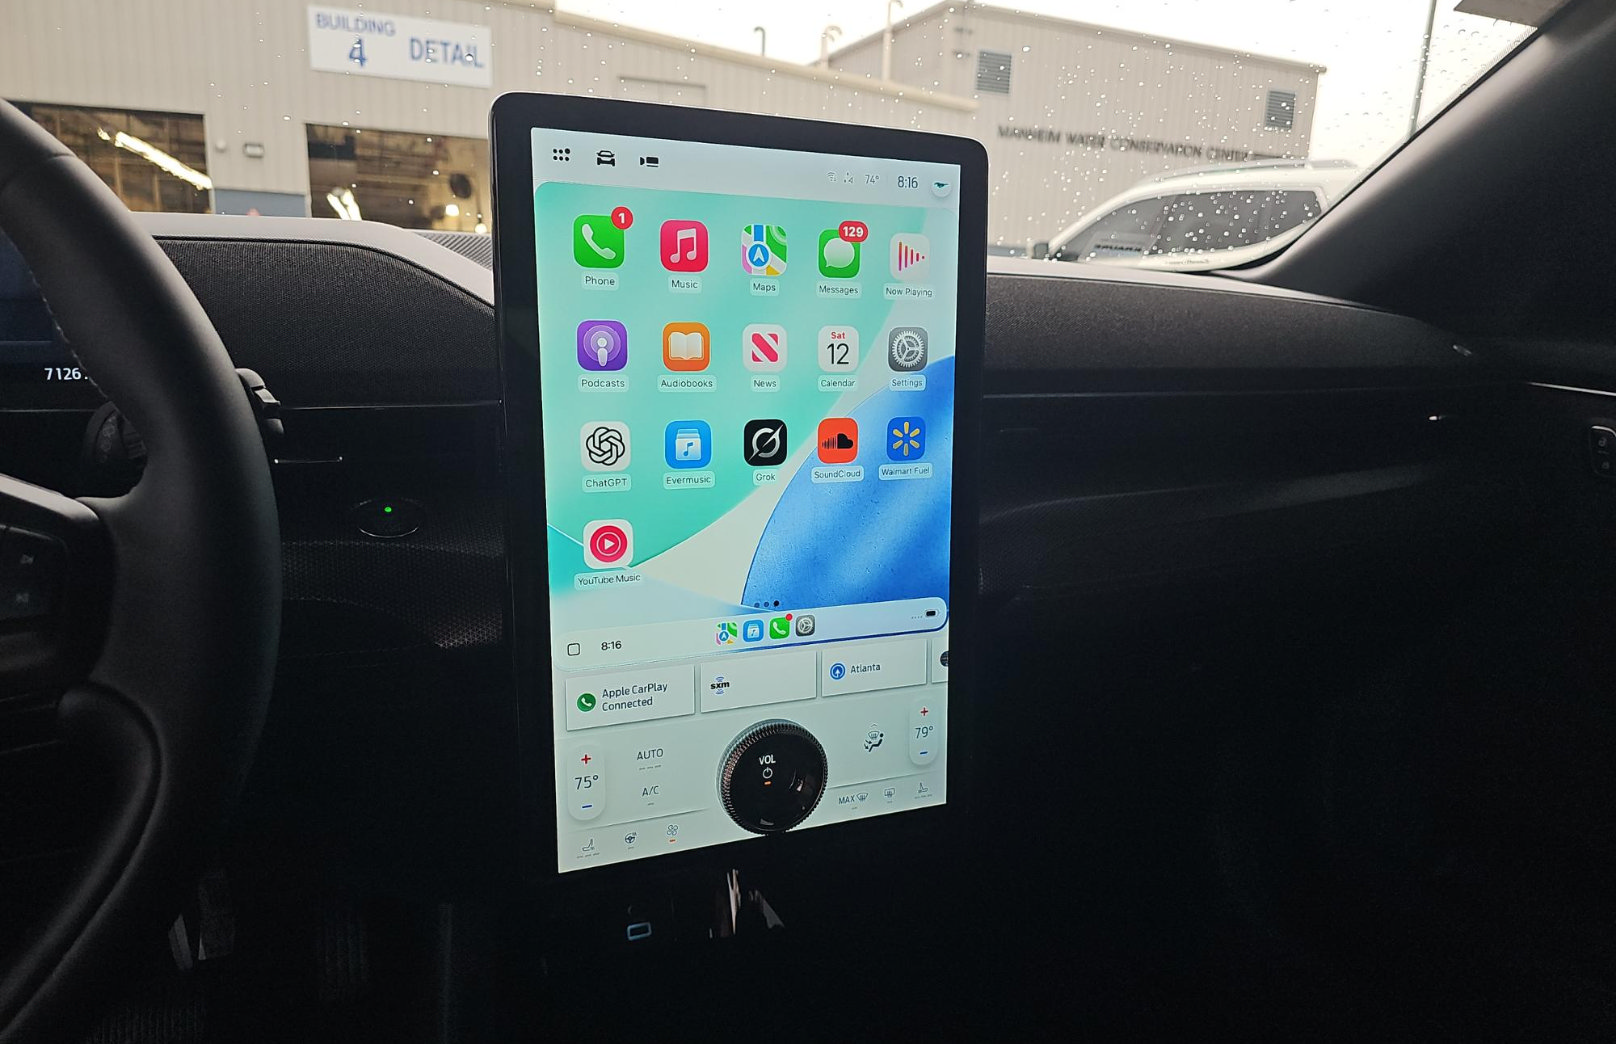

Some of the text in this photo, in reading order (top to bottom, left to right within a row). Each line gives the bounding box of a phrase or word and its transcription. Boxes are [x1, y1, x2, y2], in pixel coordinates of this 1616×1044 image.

[316, 13, 396, 37] BUILDING
[349, 37, 485, 69] 4 DETAIL
[897, 175, 919, 188] 8:16
[618, 212, 626, 224] 1
[842, 226, 865, 237] 129
[585, 275, 615, 286] Phone
[671, 279, 698, 289] Music
[752, 283, 777, 293] Maps
[818, 285, 859, 296] Messages
[885, 287, 933, 298] Now Playing
[830, 331, 846, 340] Sat
[826, 343, 850, 365] 12
[581, 378, 626, 388] Podcasts
[660, 378, 714, 388] Audiobooks
[753, 379, 777, 388] News
[820, 379, 856, 388] Calendar
[891, 379, 923, 388] Settings
[814, 469, 861, 479] SoundCloud
[881, 466, 930, 476] Walmart Fuel
[585, 477, 628, 488] ChatGPT
[666, 475, 712, 485] Evermusic
[755, 472, 776, 482] Grok
[577, 573, 641, 586] YouTube Music
[601, 640, 622, 651] 8:16
[850, 663, 881, 674] Atlanta
[602, 682, 668, 699] Apple CarPlay
[710, 681, 730, 690] sxm
[602, 696, 653, 712] Connected
[915, 725, 934, 739] 79°
[636, 748, 664, 761] AUTO
[758, 754, 777, 765] VOL
[574, 774, 599, 790] 75°
[642, 785, 660, 797] A/C
[838, 795, 856, 805] MAX
